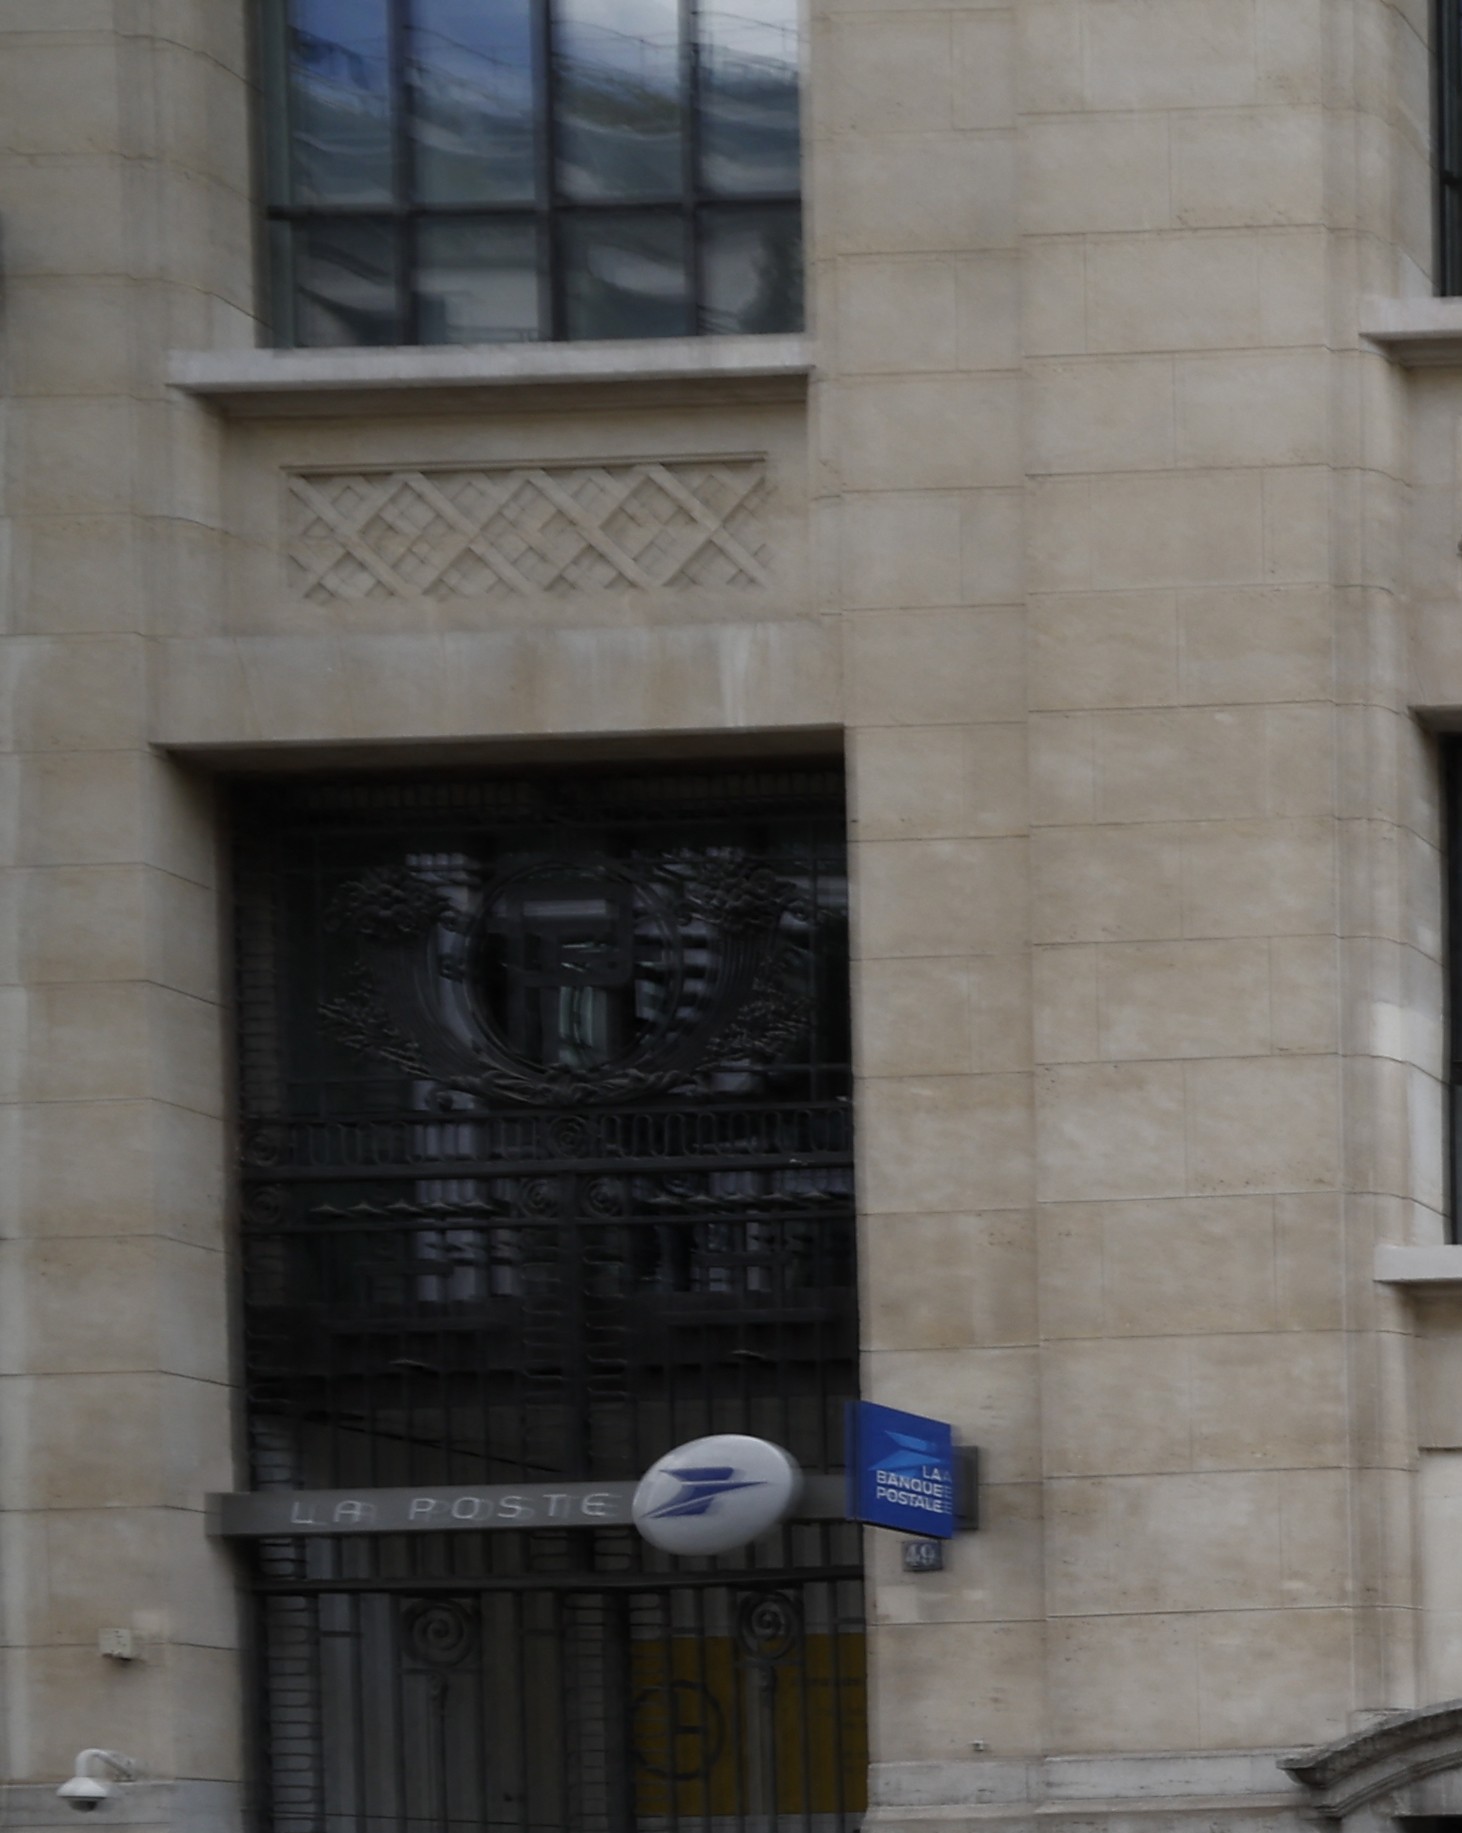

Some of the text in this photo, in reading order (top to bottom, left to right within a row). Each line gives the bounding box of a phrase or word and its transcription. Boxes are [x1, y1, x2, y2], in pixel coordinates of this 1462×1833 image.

[876, 1469, 943, 1498] BANQUE
[922, 1465, 942, 1481] LA
[290, 1492, 615, 1525] LA POSTE
[876, 1486, 944, 1513] POSTALE
